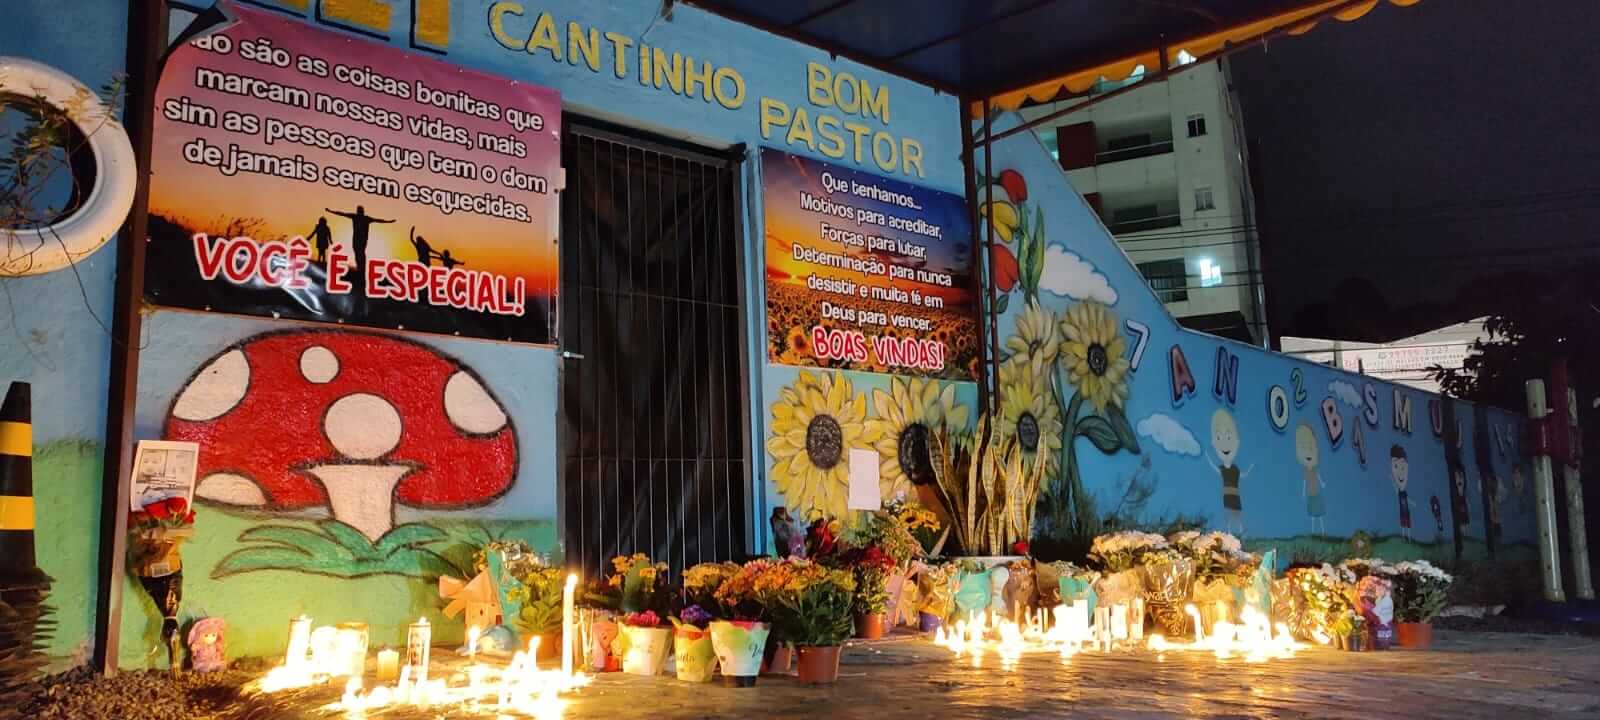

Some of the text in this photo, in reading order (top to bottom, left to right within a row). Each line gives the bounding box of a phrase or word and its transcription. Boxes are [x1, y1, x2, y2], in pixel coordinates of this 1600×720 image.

[240, 39, 290, 68] são
[297, 54, 327, 77] as
[333, 65, 411, 98] coisas
[416, 80, 501, 120] bonitas
[505, 106, 544, 132] que
[486, 1, 747, 111] CANTINHO
[196, 68, 527, 158] marcam nossas vidas, mais
[807, 62, 890, 125] BOM
[163, 97, 547, 193] sim as pessoas que tem o dom
[759, 96, 926, 178] PASTOR
[183, 137, 532, 223] de jamais serem esquecidas.
[821, 172, 849, 193] Que
[800, 193, 942, 240] Motivos para acreditar,
[820, 222, 928, 260] Forças para lutar,
[193, 232, 526, 317] VOCÊ É ESPECIAL!
[792, 243, 952, 287] Determinação para nunca
[807, 273, 943, 309] desistir e muita fé em
[811, 325, 945, 370] BOAS VINDAS!
[821, 302, 933, 331] Deus para vencer.
[1124, 320, 1150, 372] 7
[1170, 343, 1196, 402] A
[1215, 346, 1239, 404] N
